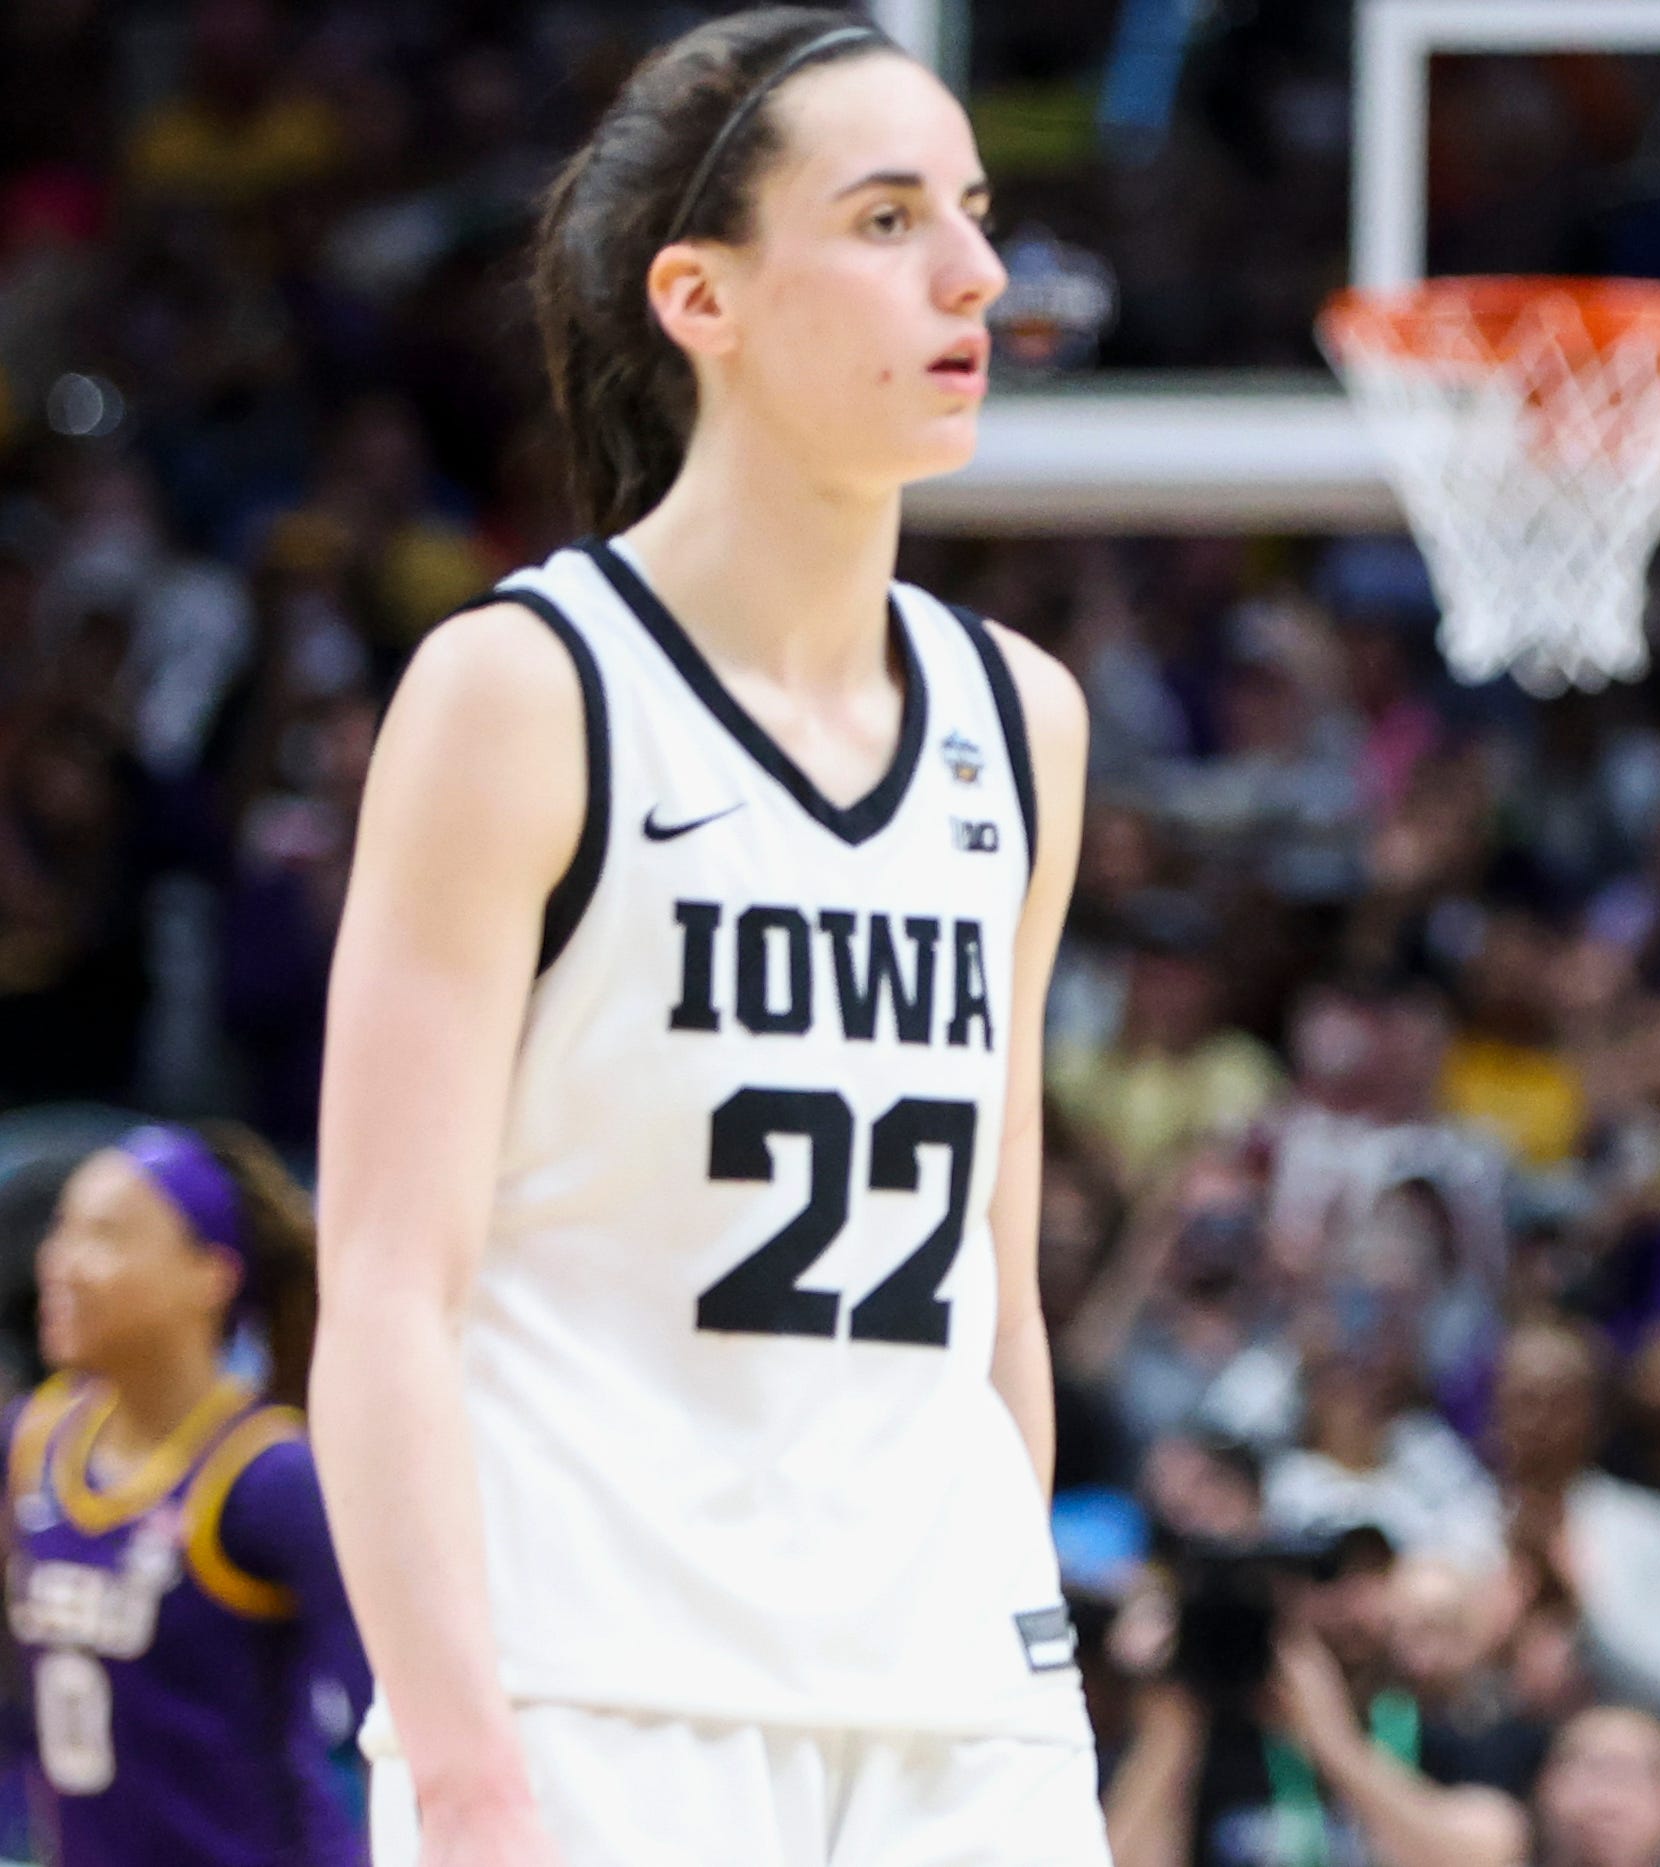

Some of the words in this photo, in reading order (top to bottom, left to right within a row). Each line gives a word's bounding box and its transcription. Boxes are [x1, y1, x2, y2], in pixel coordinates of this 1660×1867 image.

[668, 898, 993, 1052] IOWA
[695, 1085, 978, 1347] 22
[35, 1650, 117, 1796] 0
